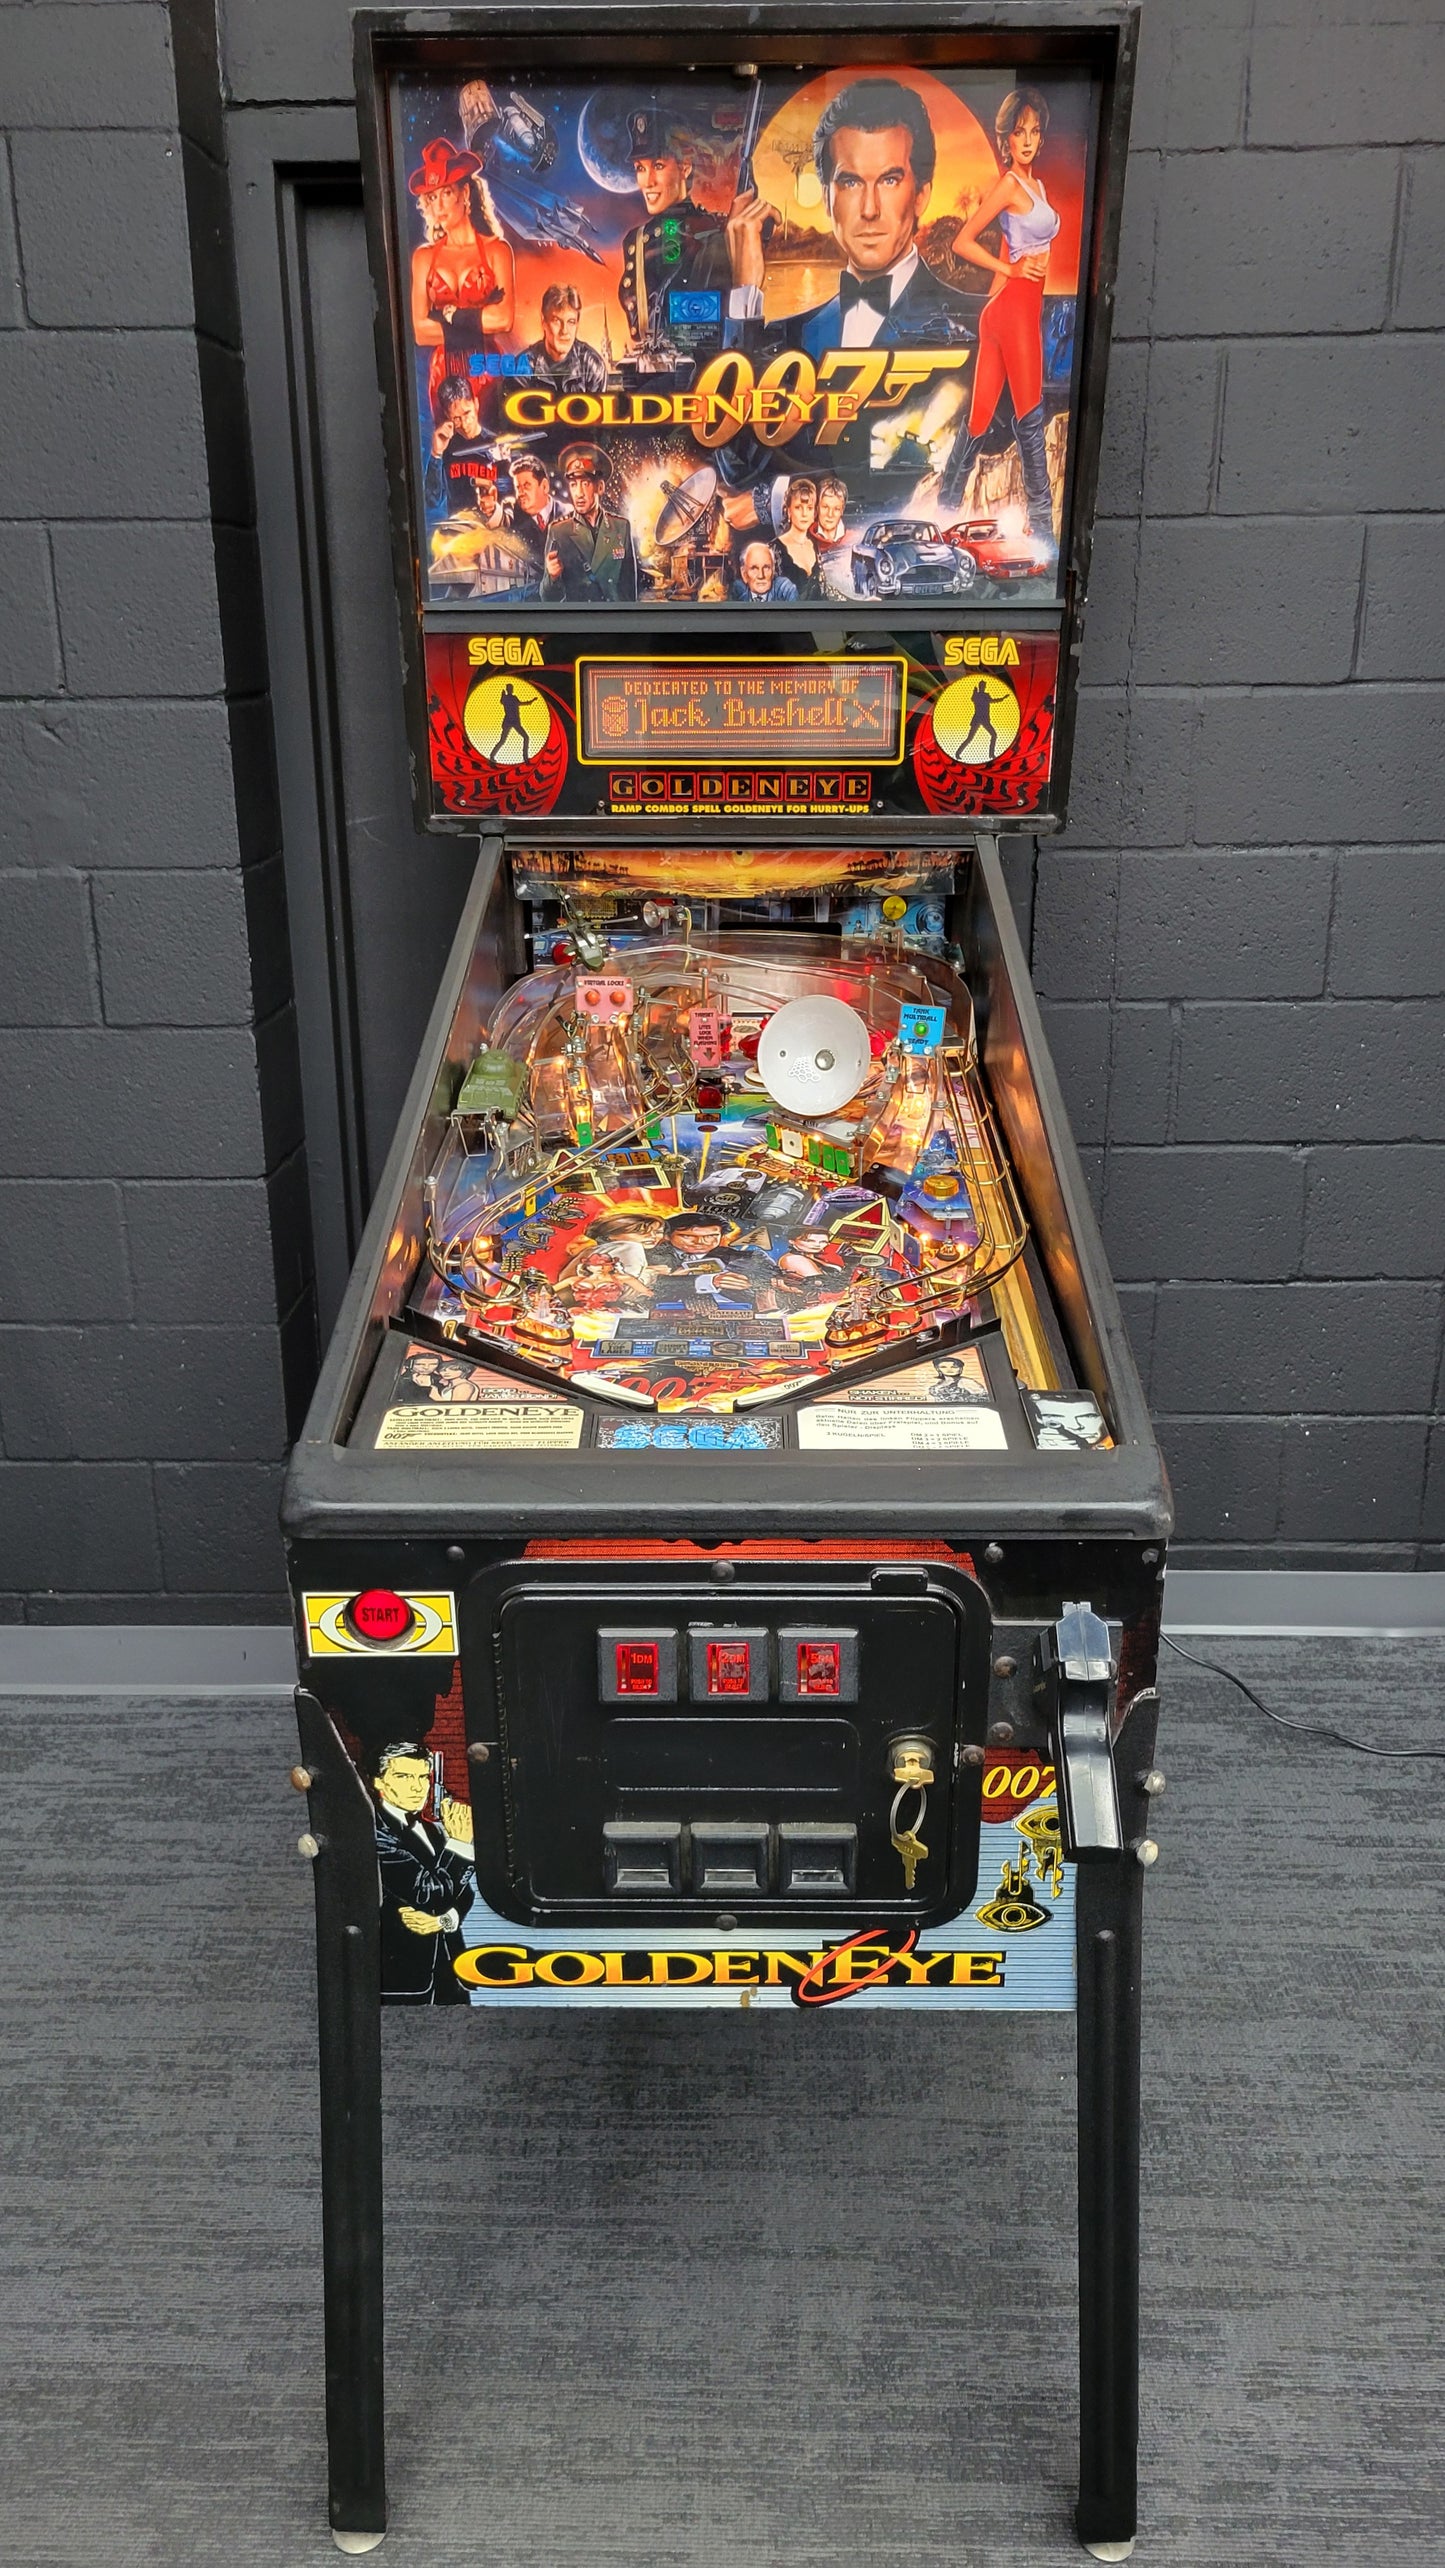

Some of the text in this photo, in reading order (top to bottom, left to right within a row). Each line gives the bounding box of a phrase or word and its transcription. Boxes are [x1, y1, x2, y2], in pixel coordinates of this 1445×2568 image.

[469, 353, 532, 376] SEGA
[504, 387, 859, 426] GOLDENEYE
[691, 350, 892, 447] 007
[468, 637, 545, 666] SEGA
[944, 637, 1020, 666] SEGA
[624, 680, 860, 695] DEDICATED TO THE MEMORY OF
[634, 697, 849, 734] Jack Bushell
[612, 778, 867, 797] GOLDENEYE
[611, 804, 870, 813] RAMP COMBOS SPELL GOLDENEYE FOR HURRY-UPS
[392, 1407, 580, 1417] GOLDENEYE
[614, 1425, 768, 1450] SEGA
[361, 1607, 400, 1622] START
[453, 1945, 1003, 1987] GOLDENEYE
